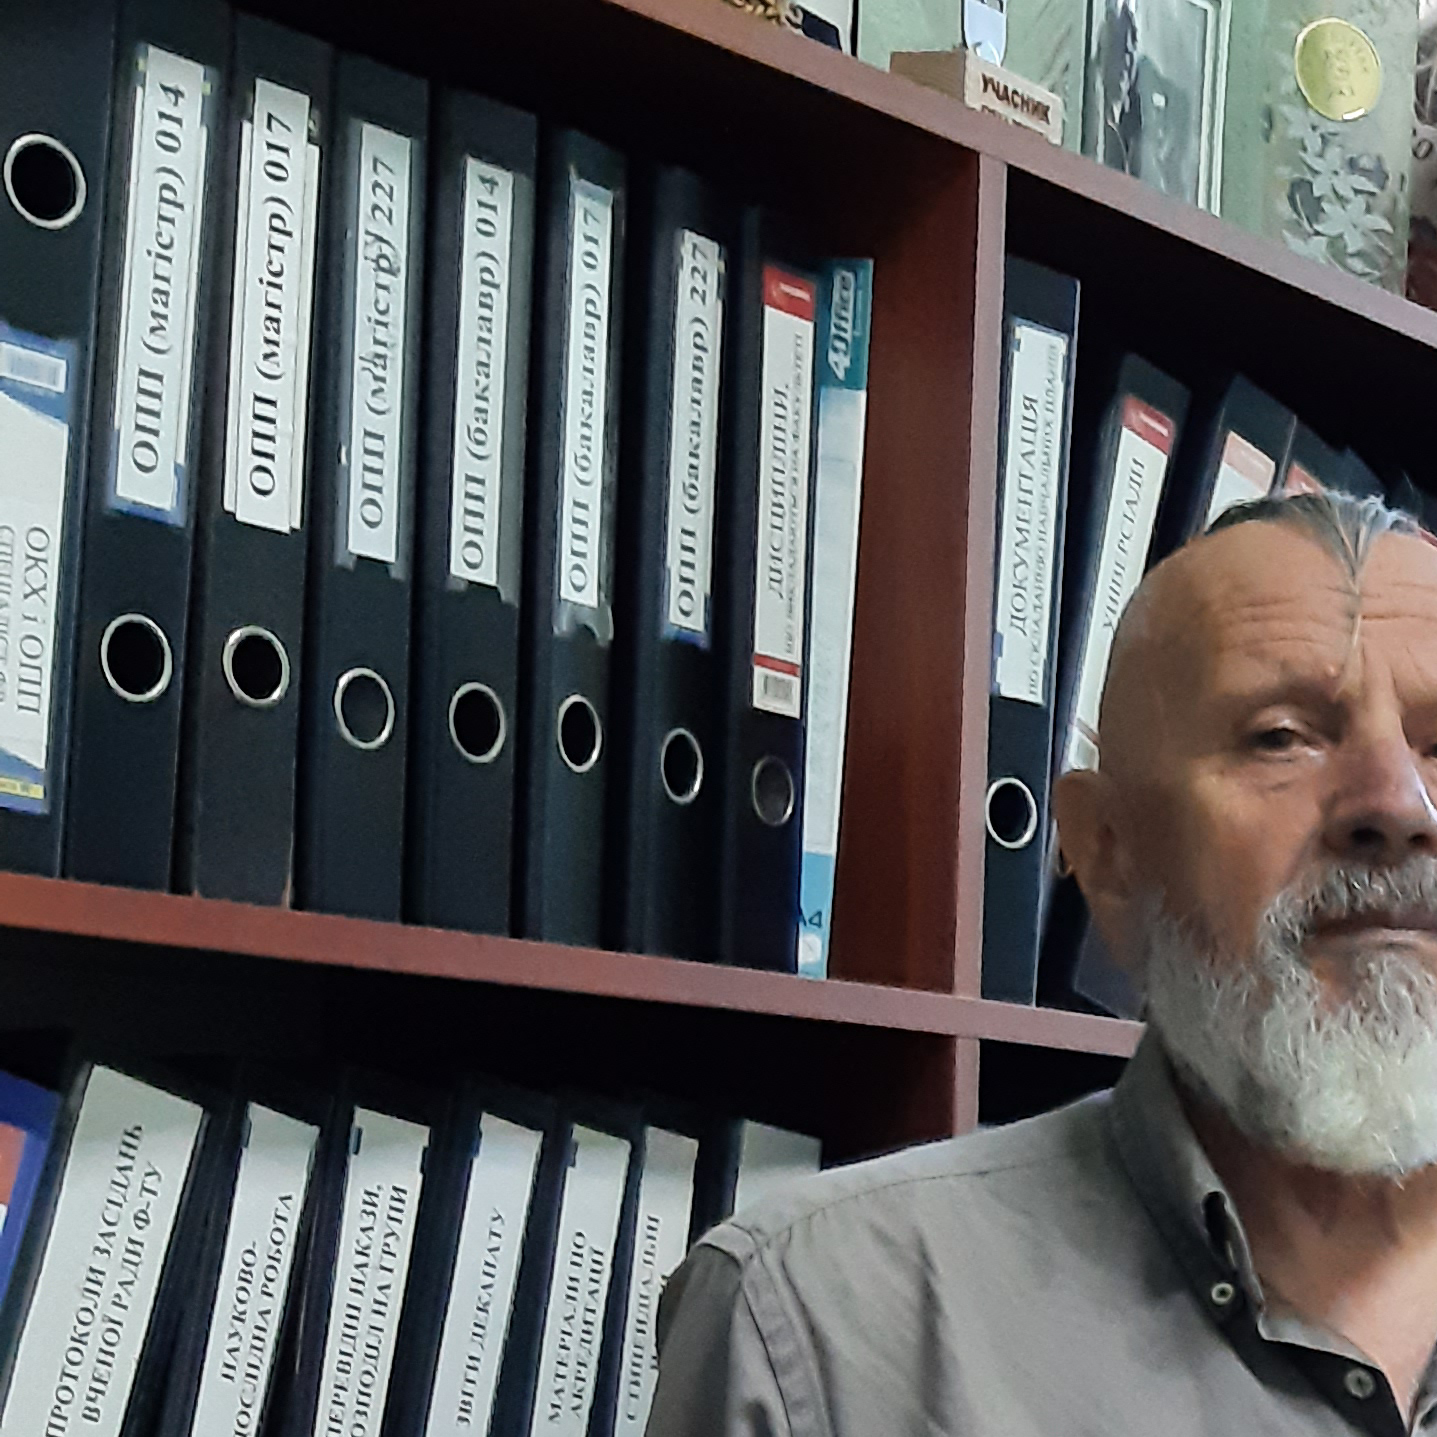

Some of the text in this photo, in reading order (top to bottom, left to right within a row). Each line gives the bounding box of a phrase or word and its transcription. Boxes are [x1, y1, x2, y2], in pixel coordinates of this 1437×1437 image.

[981, 73, 1052, 125] УЧАСНИК
[131, 82, 186, 474] ОПП (магістр) 014
[249, 113, 294, 498] ОПП (магістр) 017
[360, 157, 400, 530] ОПП (магістр) 227
[462, 173, 501, 570] ОПП (бакалавр) 014
[569, 207, 602, 592] ОПП (бакалавр) 017
[678, 242, 708, 618] ОПП (бакалавр) 227
[24, 527, 50, 605] ОКХ
[1010, 394, 1038, 637] ДОКУМЕНТАЦІЯ
[17, 634, 44, 714] ОПП
[82, 1161, 162, 1423] ВЧЕНОЇ РАДИ Ф-ТУ
[92, 1124, 143, 1259] ЗАСІДАНЬ
[260, 1192, 293, 1299] РОБОТА
[379, 1184, 408, 1273] ГРУПИ
[220, 1241, 257, 1383] НАУКОВО-
[371, 1282, 391, 1318] НА
[457, 1206, 505, 1428] ЗВІТИ ДЕКАНАТУ
[548, 1230, 586, 1423] МАТЕРІАЛИ ПО
